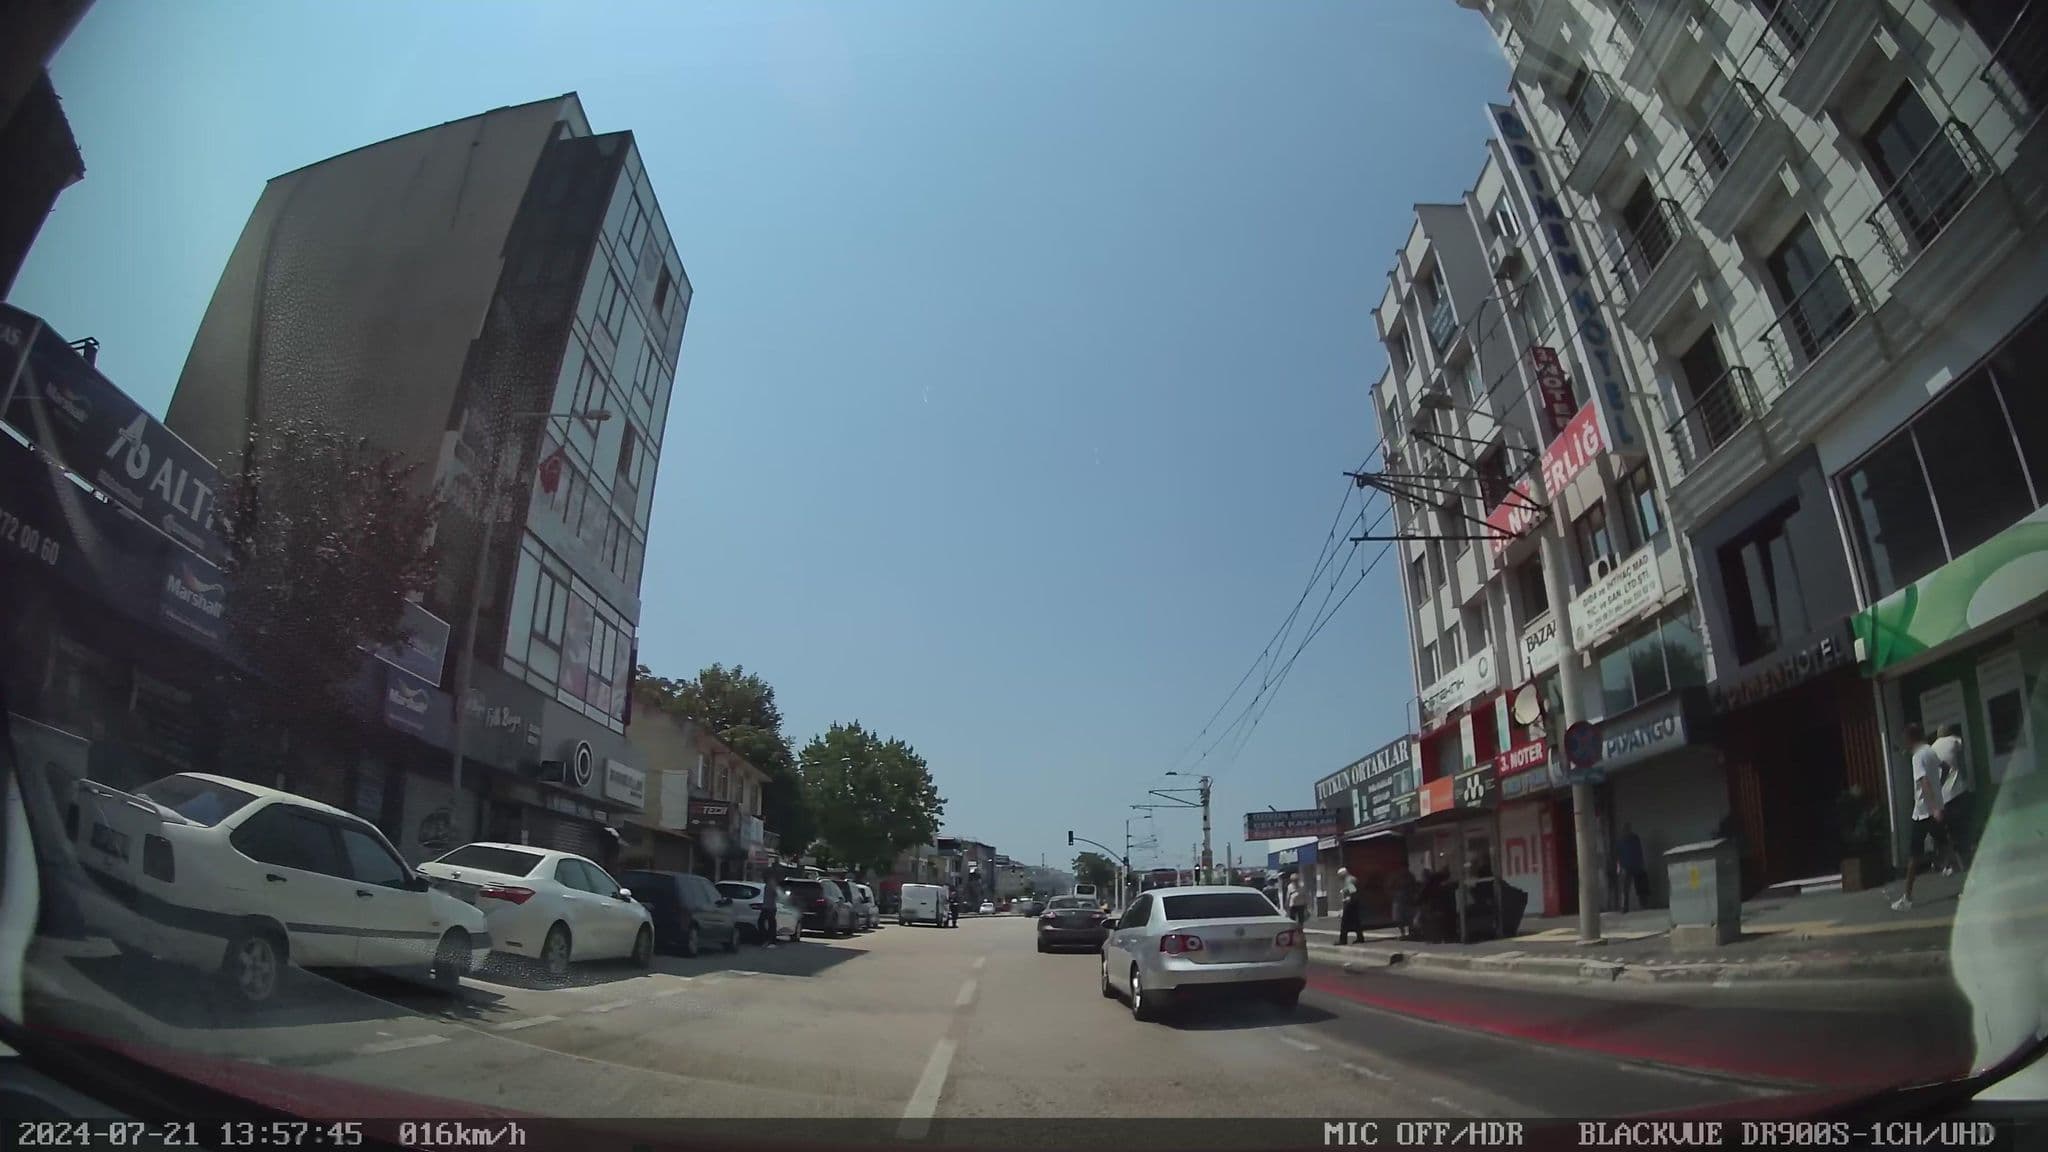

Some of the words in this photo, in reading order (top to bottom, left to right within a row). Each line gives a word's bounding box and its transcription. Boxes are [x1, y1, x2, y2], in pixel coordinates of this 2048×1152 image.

[167, 574, 224, 619] Marshall
[1316, 768, 1350, 800] TUTKUN
[1351, 739, 1409, 785] ORTAKLAR
[1510, 743, 1543, 768] NOTER
